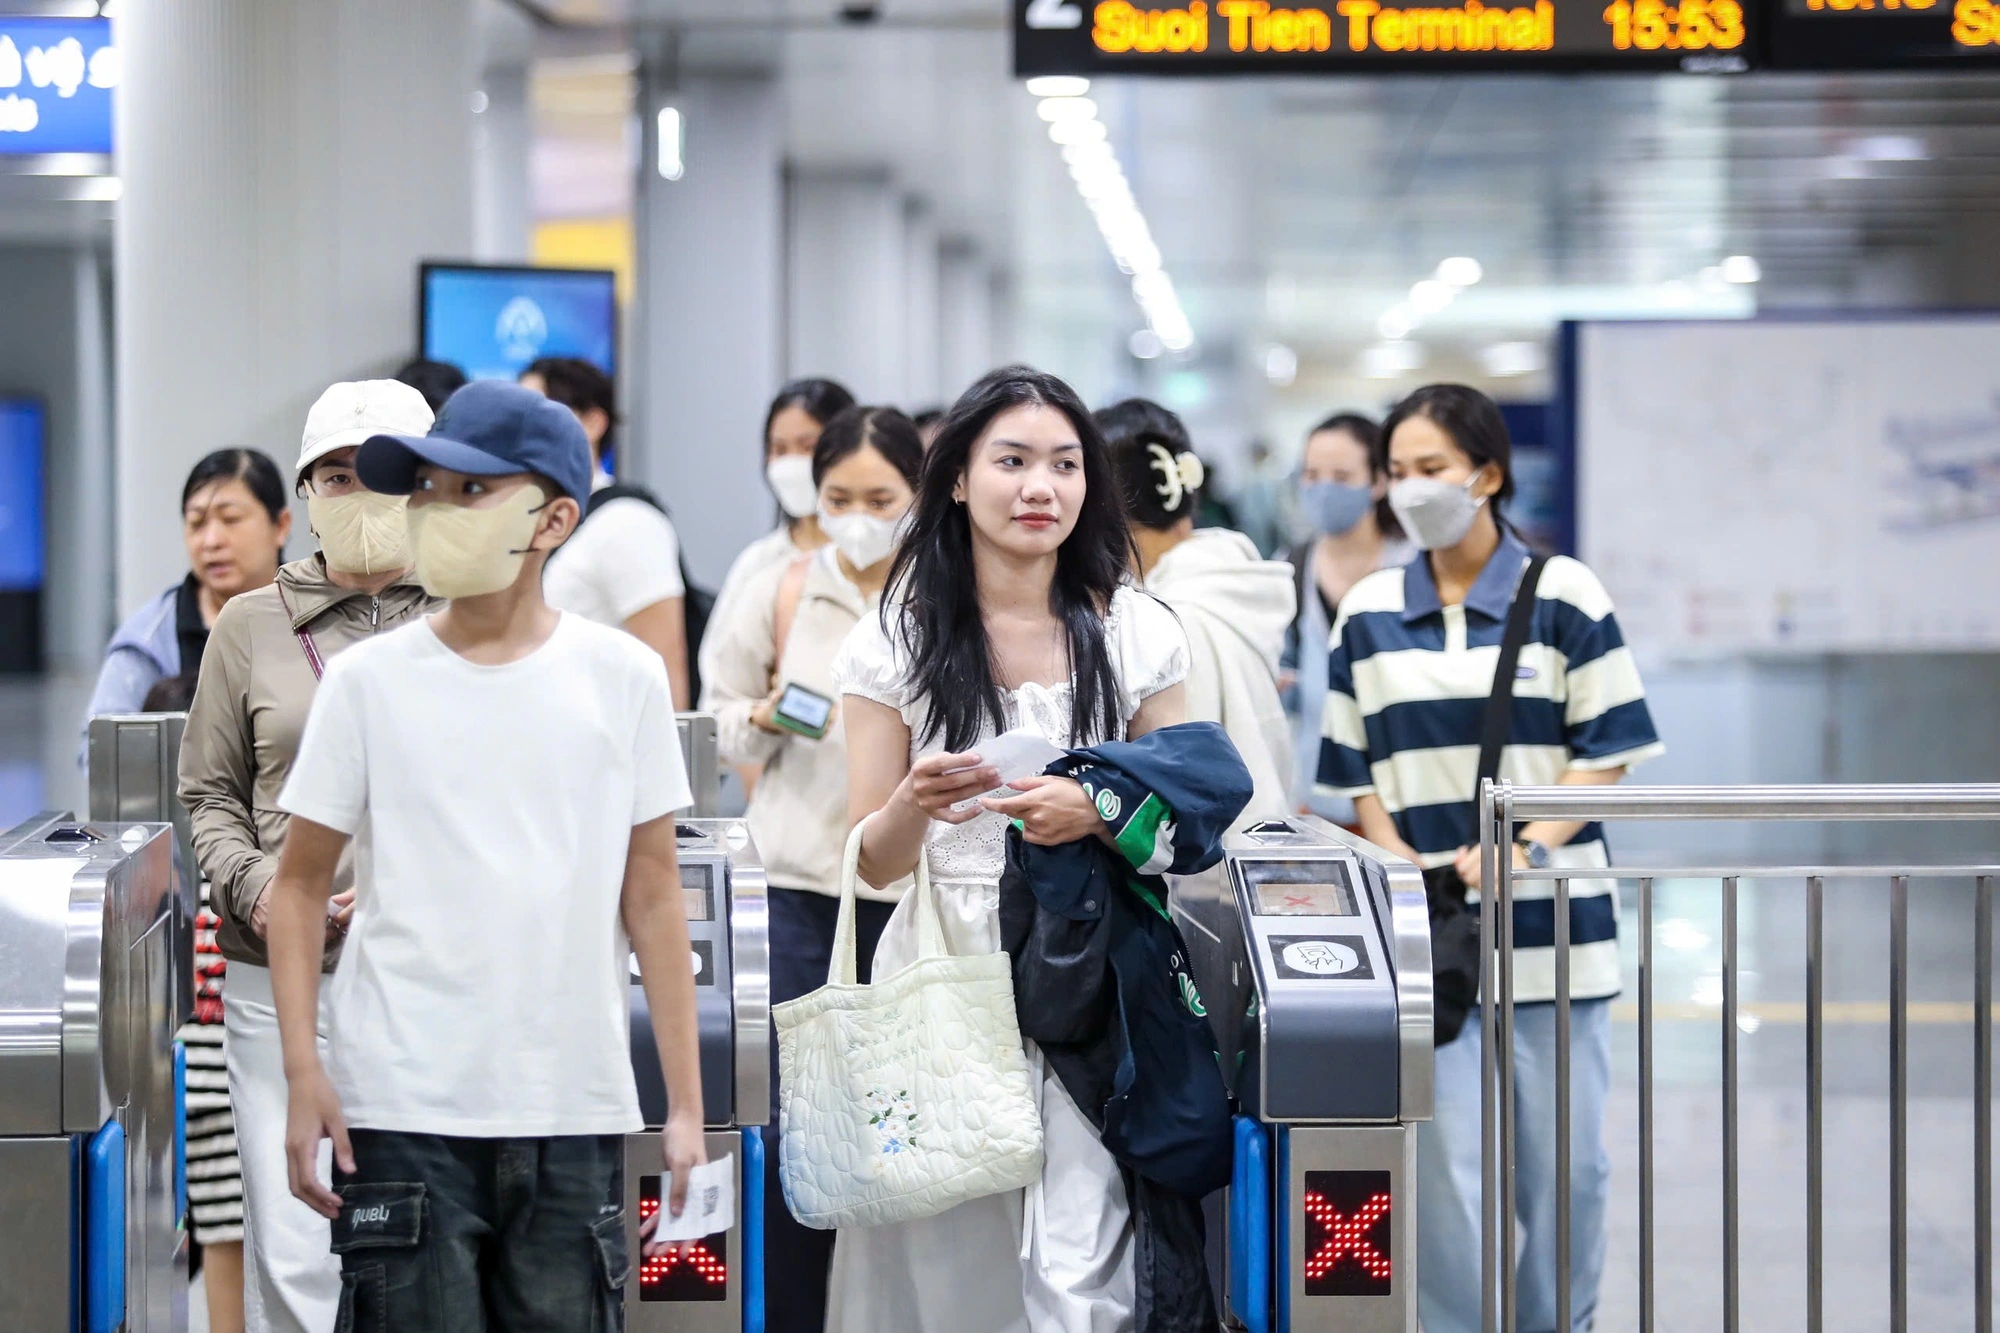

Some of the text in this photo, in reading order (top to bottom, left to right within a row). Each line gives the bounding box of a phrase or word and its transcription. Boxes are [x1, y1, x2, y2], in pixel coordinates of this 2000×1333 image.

[1092, 0, 1208, 52] Suoi
[1216, 0, 1330, 52] Tien
[1336, 0, 1554, 52] Terminal
[1603, 0, 1745, 50] 15:53
